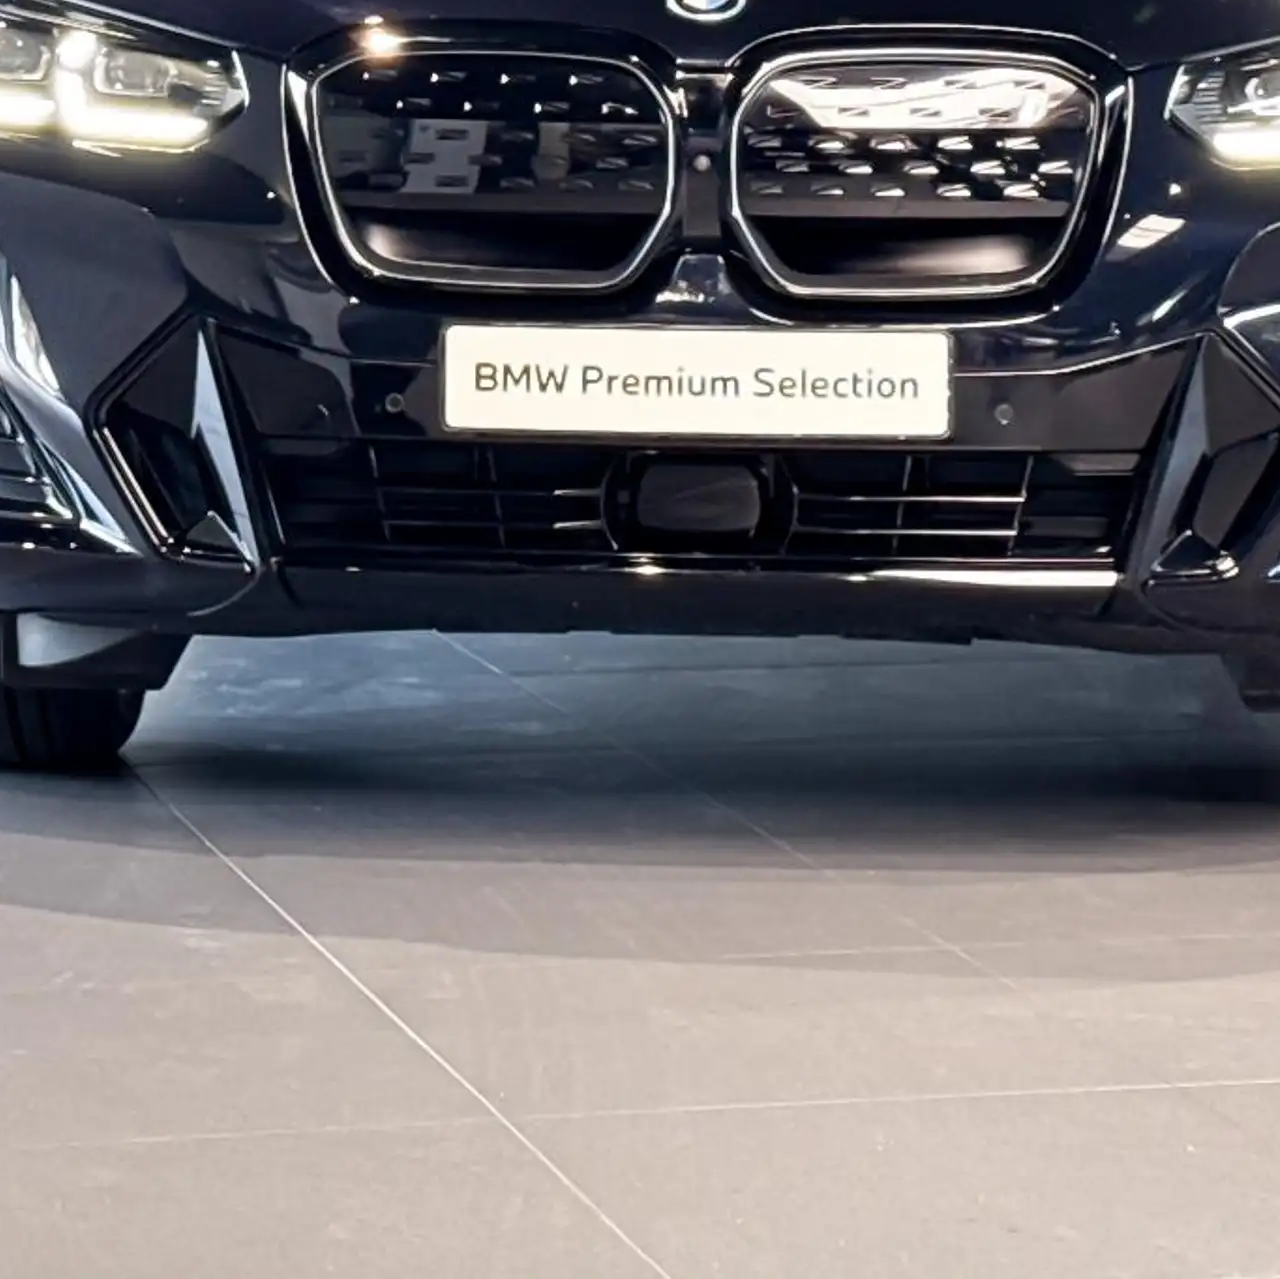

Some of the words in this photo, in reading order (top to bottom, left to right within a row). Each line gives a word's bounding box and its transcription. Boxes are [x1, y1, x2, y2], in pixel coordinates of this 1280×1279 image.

[474, 362, 569, 394] BMW
[581, 365, 740, 397] Premium
[753, 367, 919, 399] Selection
